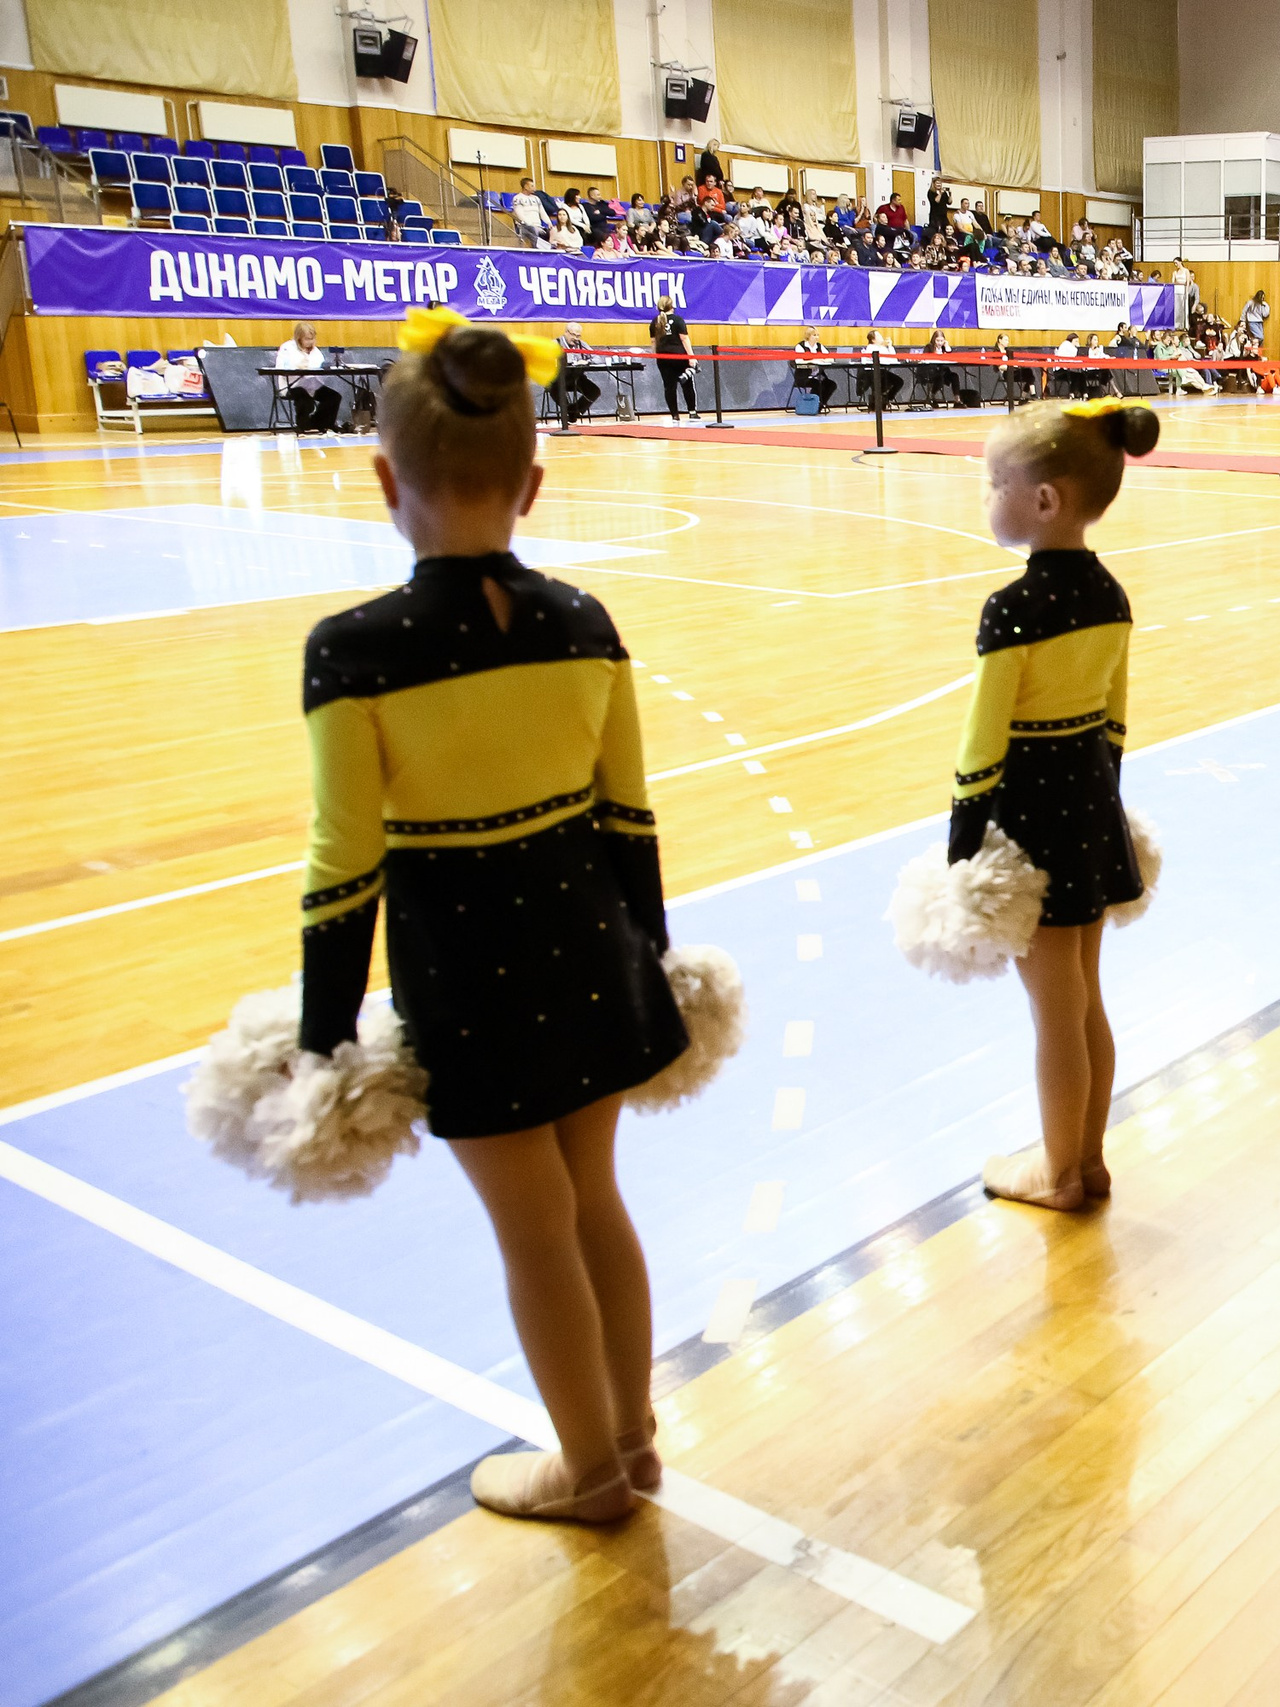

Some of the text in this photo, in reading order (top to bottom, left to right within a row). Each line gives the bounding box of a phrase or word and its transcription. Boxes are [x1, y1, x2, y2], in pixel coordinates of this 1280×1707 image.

[149, 250, 458, 302] ДИНАМО-МЕТАР
[518, 265, 688, 309] ЧЕЛЯБИНСК
[980, 286, 1004, 303] ПОКА
[1004, 287, 1020, 304] МЫ
[1054, 290, 1070, 306] МЫ
[1070, 291, 1126, 308] НЕПОБЕДИМЫ!
